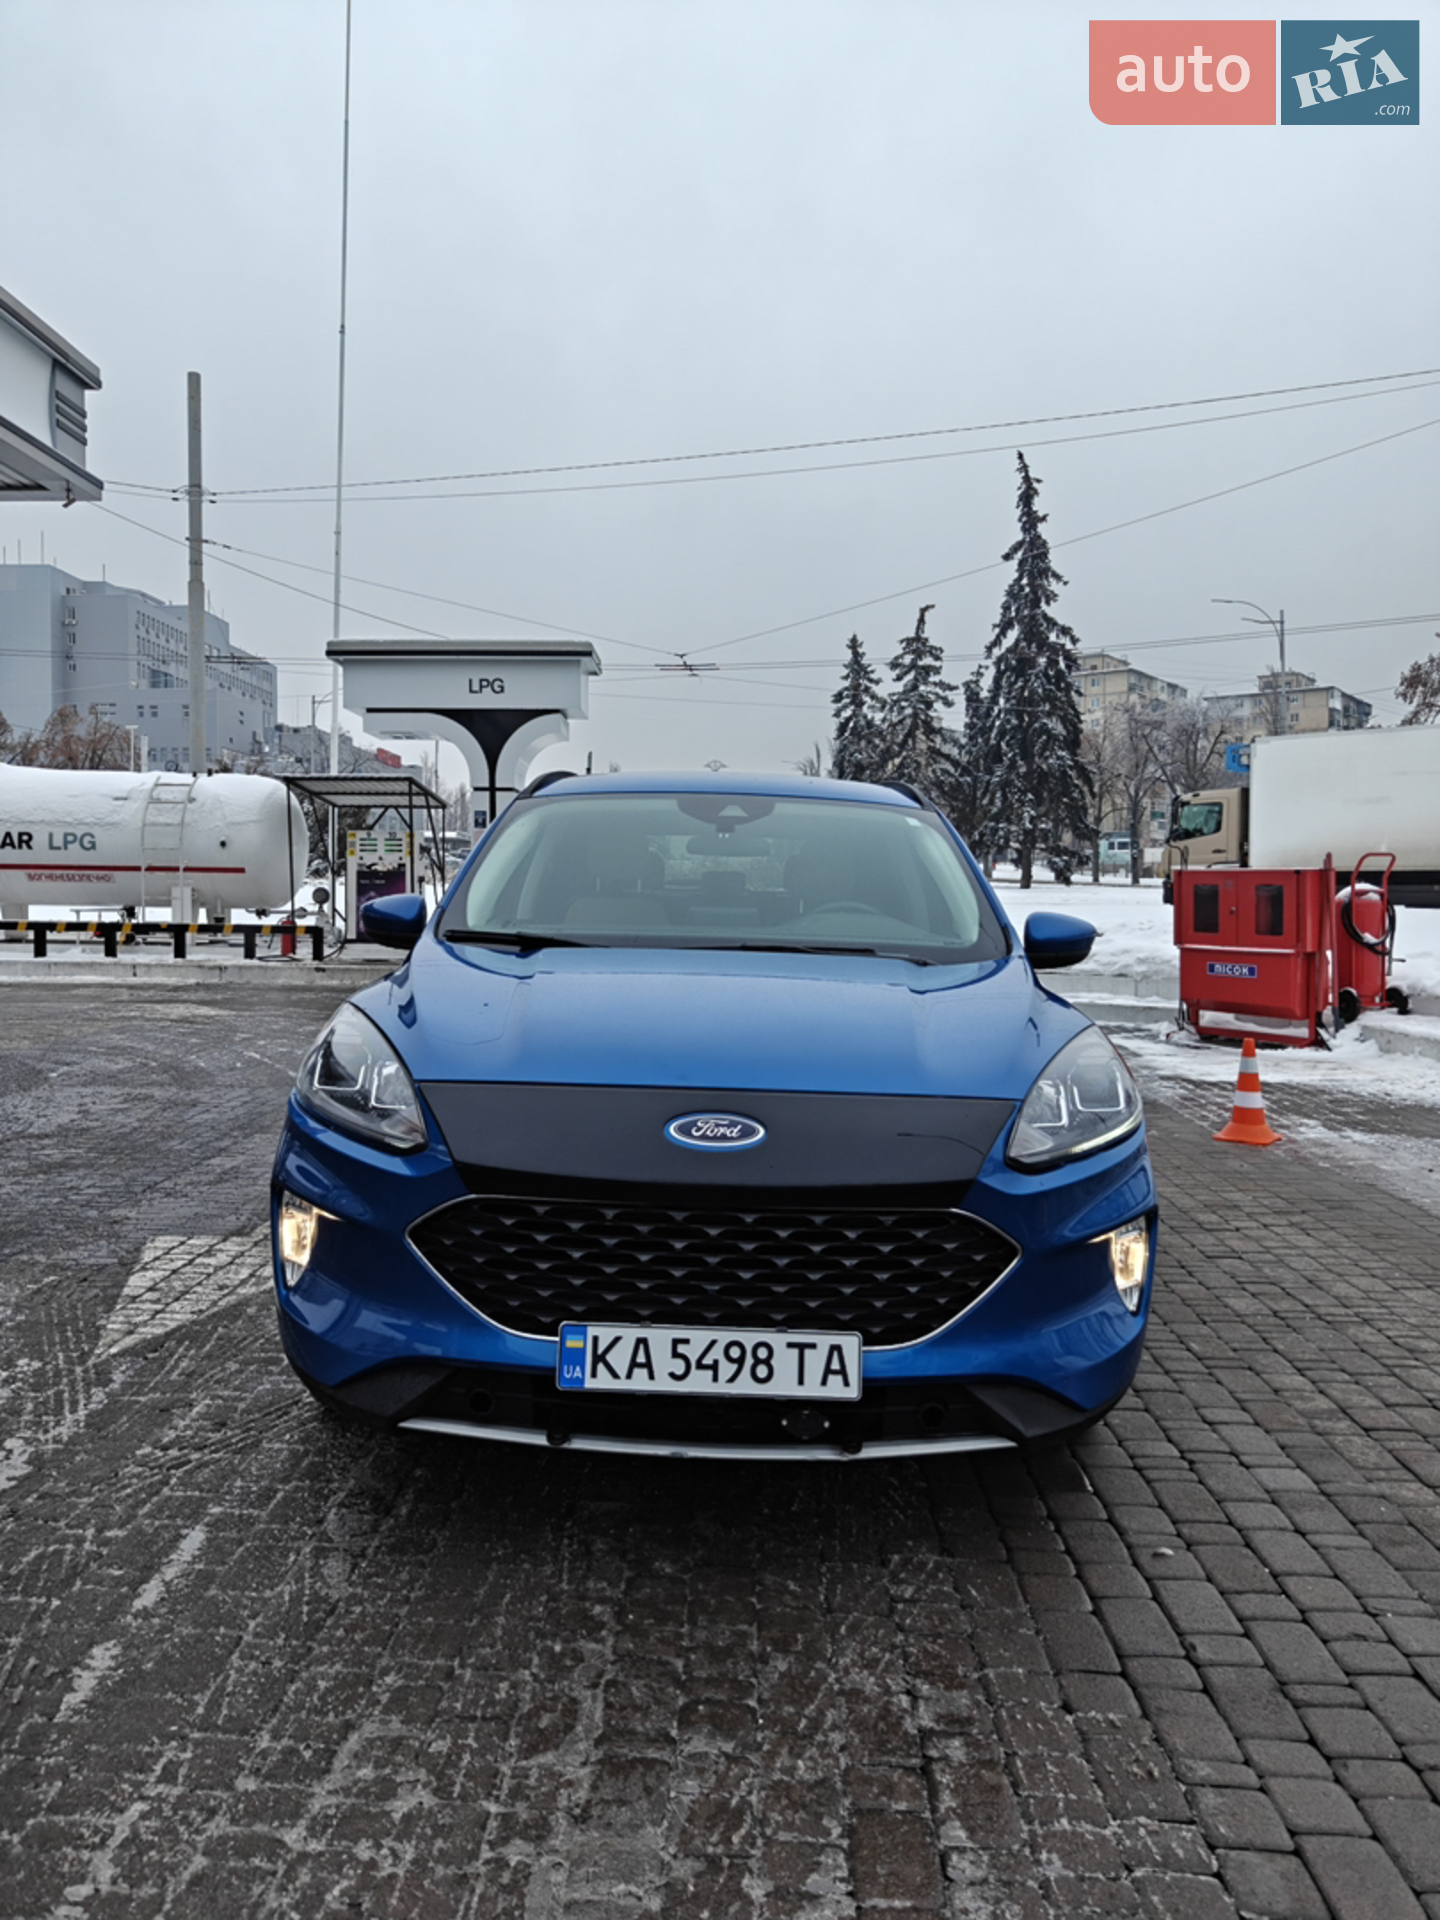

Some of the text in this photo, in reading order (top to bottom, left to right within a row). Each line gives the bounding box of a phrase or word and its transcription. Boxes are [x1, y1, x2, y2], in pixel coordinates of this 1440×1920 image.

[468, 678, 505, 694] LPG
[48, 832, 97, 851] LPG
[1214, 964, 1249, 975] ПІСОК
[691, 1119, 742, 1138] Ford
[590, 1335, 850, 1388] KA 5498 TA
[563, 1365, 583, 1379] UA
